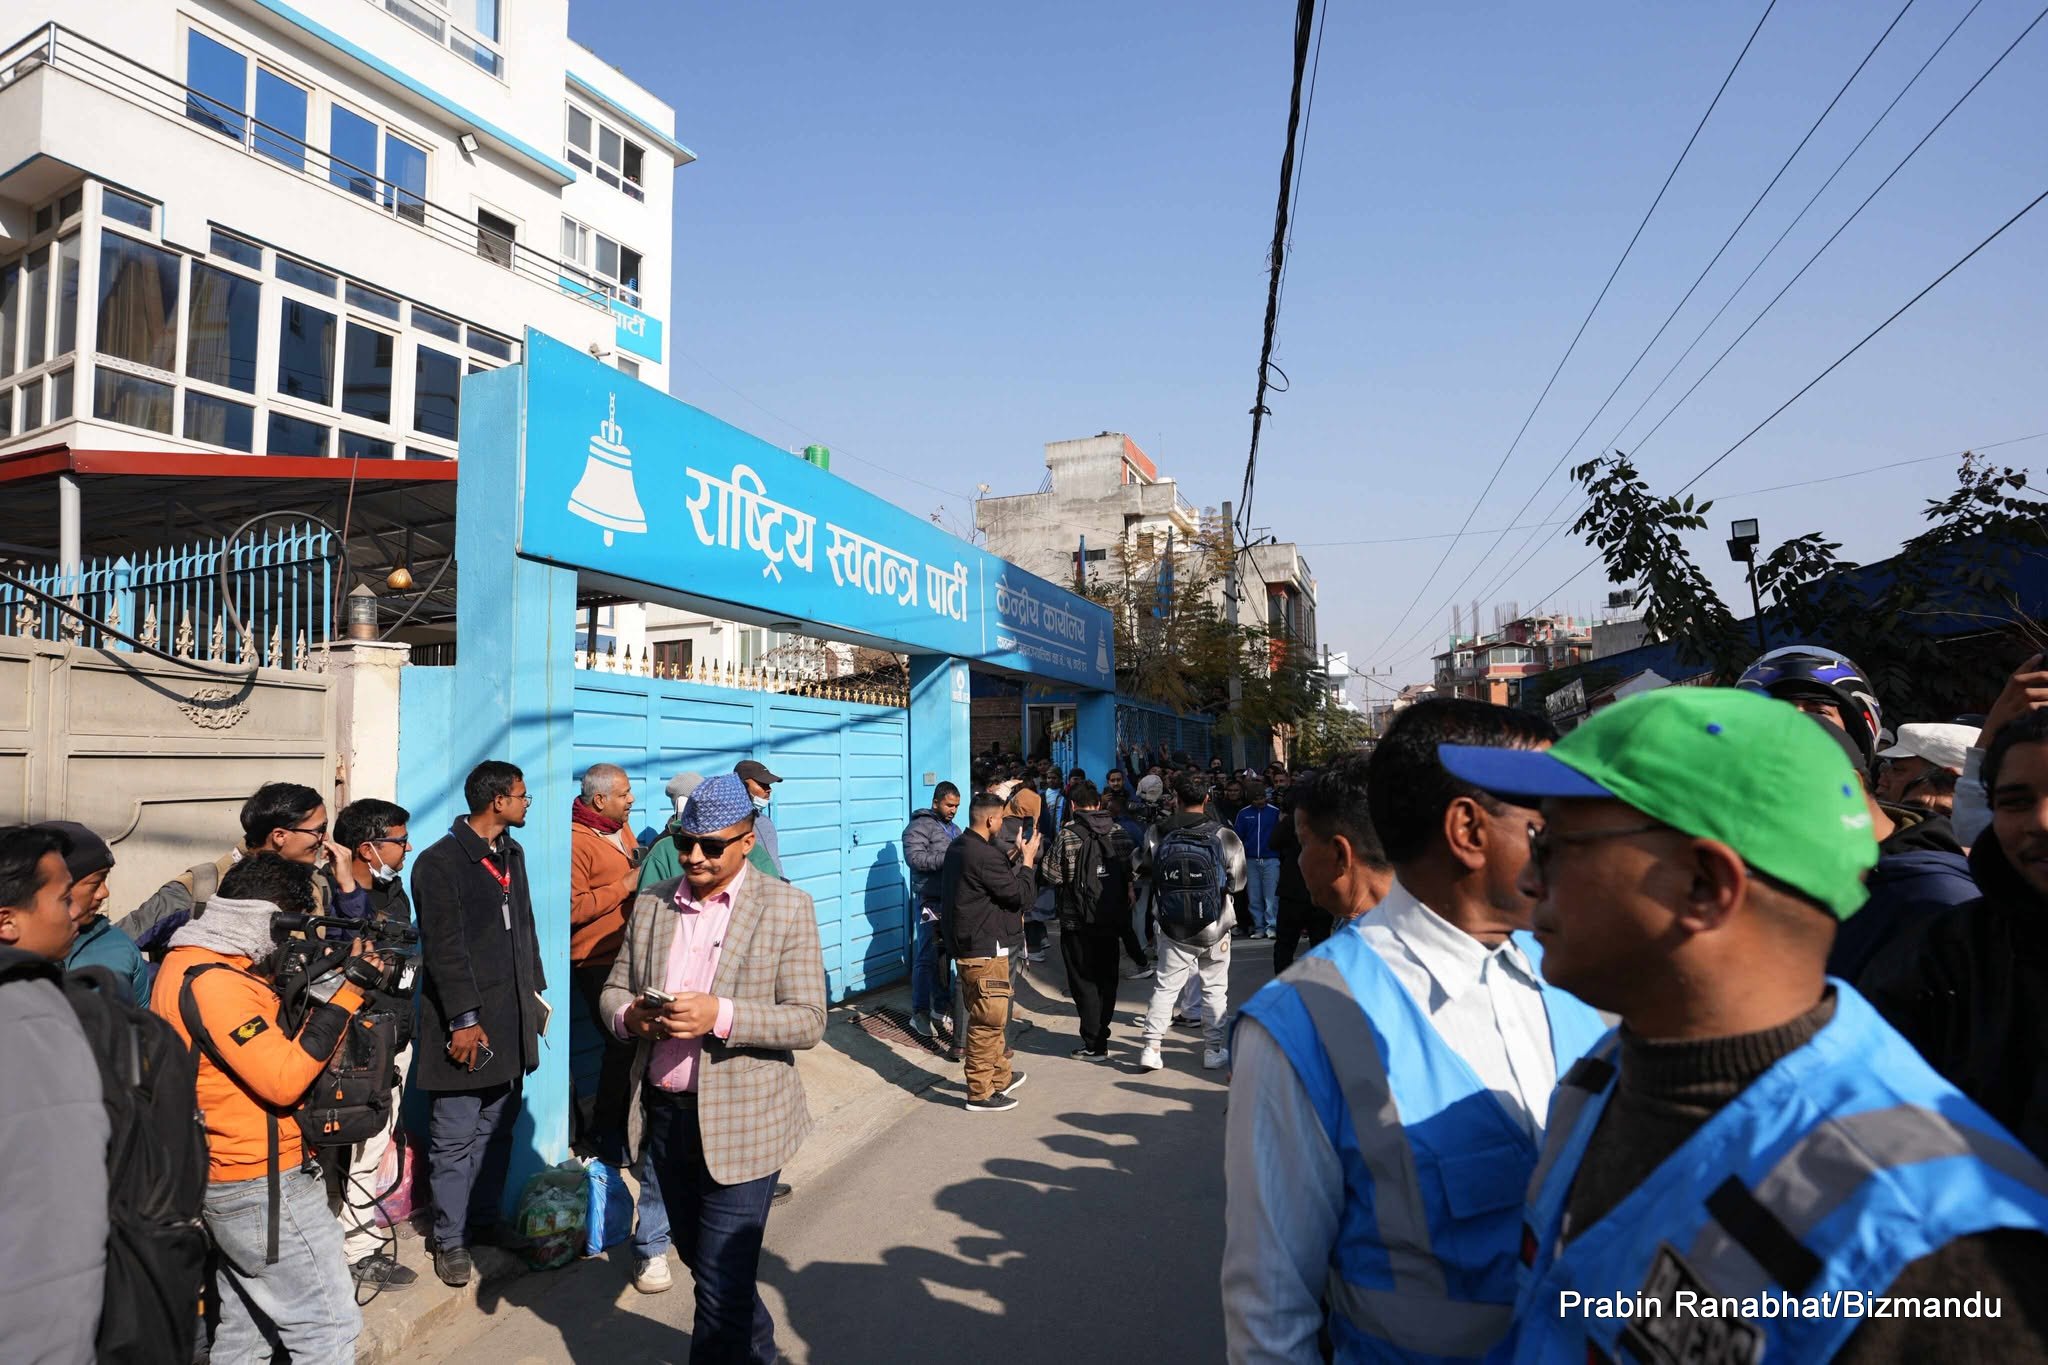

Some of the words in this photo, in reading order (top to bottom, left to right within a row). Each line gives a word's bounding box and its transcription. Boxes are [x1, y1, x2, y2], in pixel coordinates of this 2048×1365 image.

[686, 464, 816, 584] राष्ट्रिय
[826, 522, 919, 607] स्वतन्त्र
[926, 560, 968, 622] पार्टी
[995, 574, 1040, 627] केन्द्रीय
[1042, 601, 1086, 644] कार्यालय
